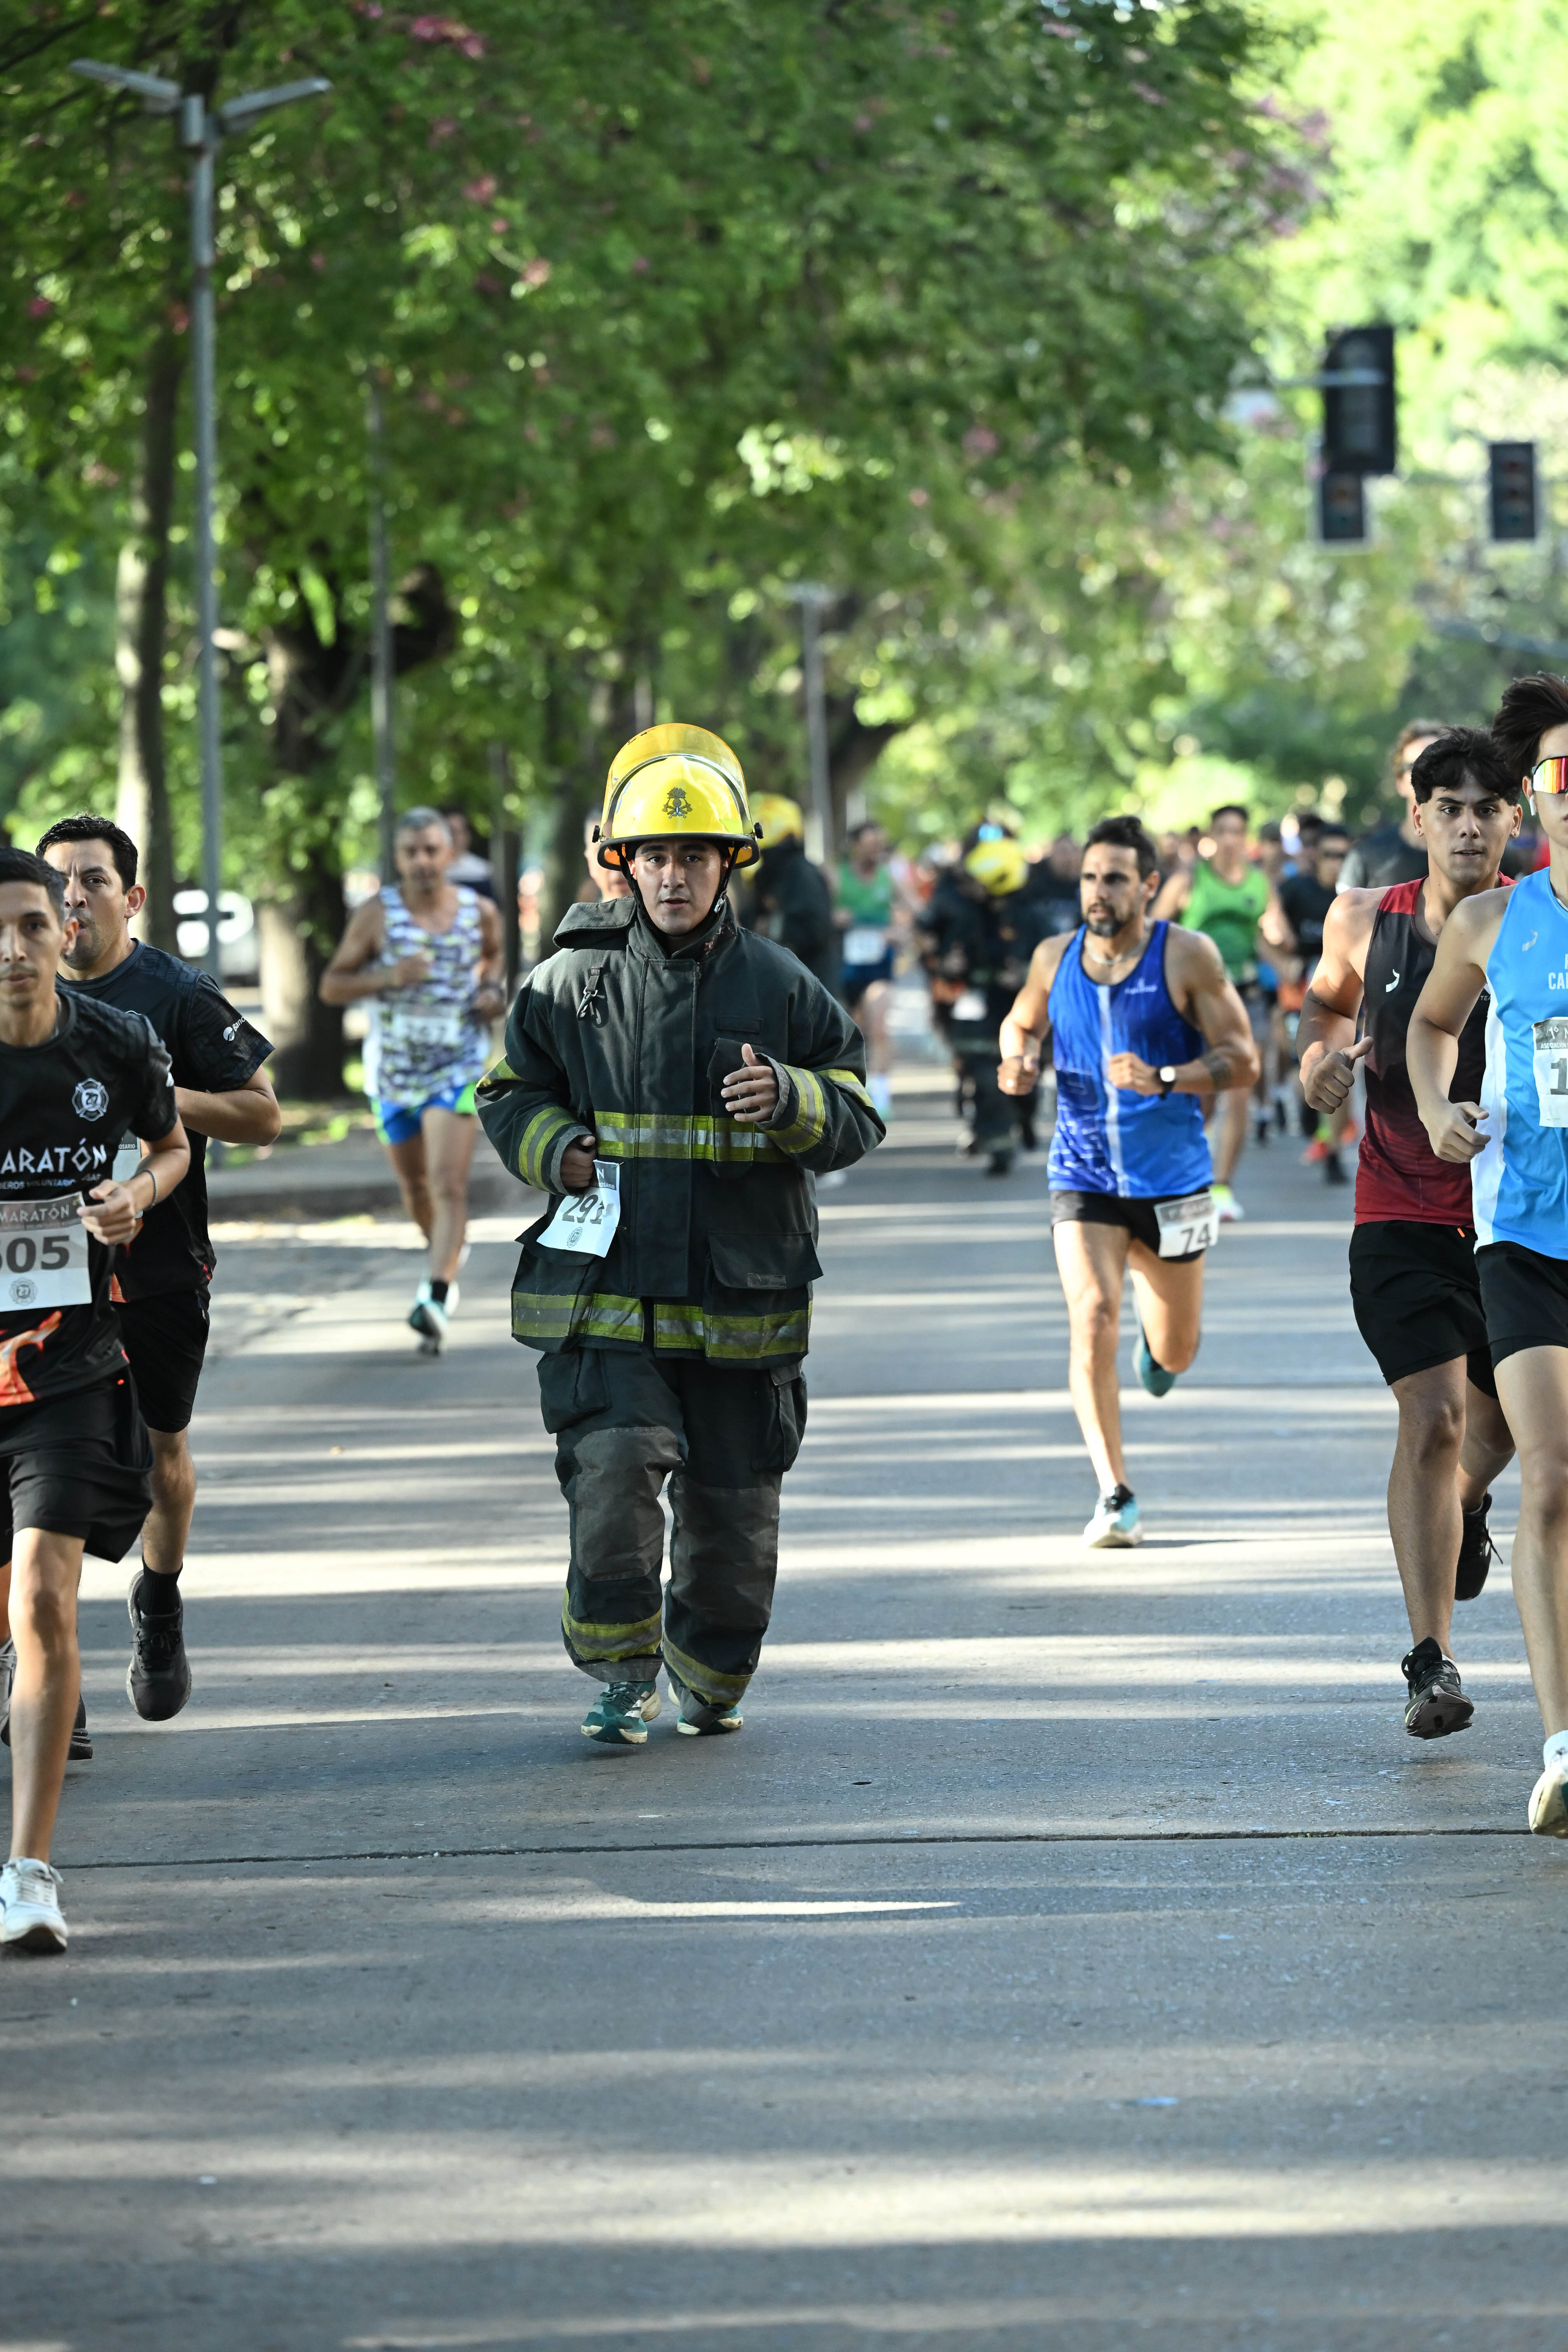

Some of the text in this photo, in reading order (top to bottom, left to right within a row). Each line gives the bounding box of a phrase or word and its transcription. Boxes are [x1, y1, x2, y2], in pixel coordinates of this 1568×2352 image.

[1548, 972, 1568, 990] CA
[1181, 1223, 1211, 1253] 74
[0, 1235, 70, 1274] 05
